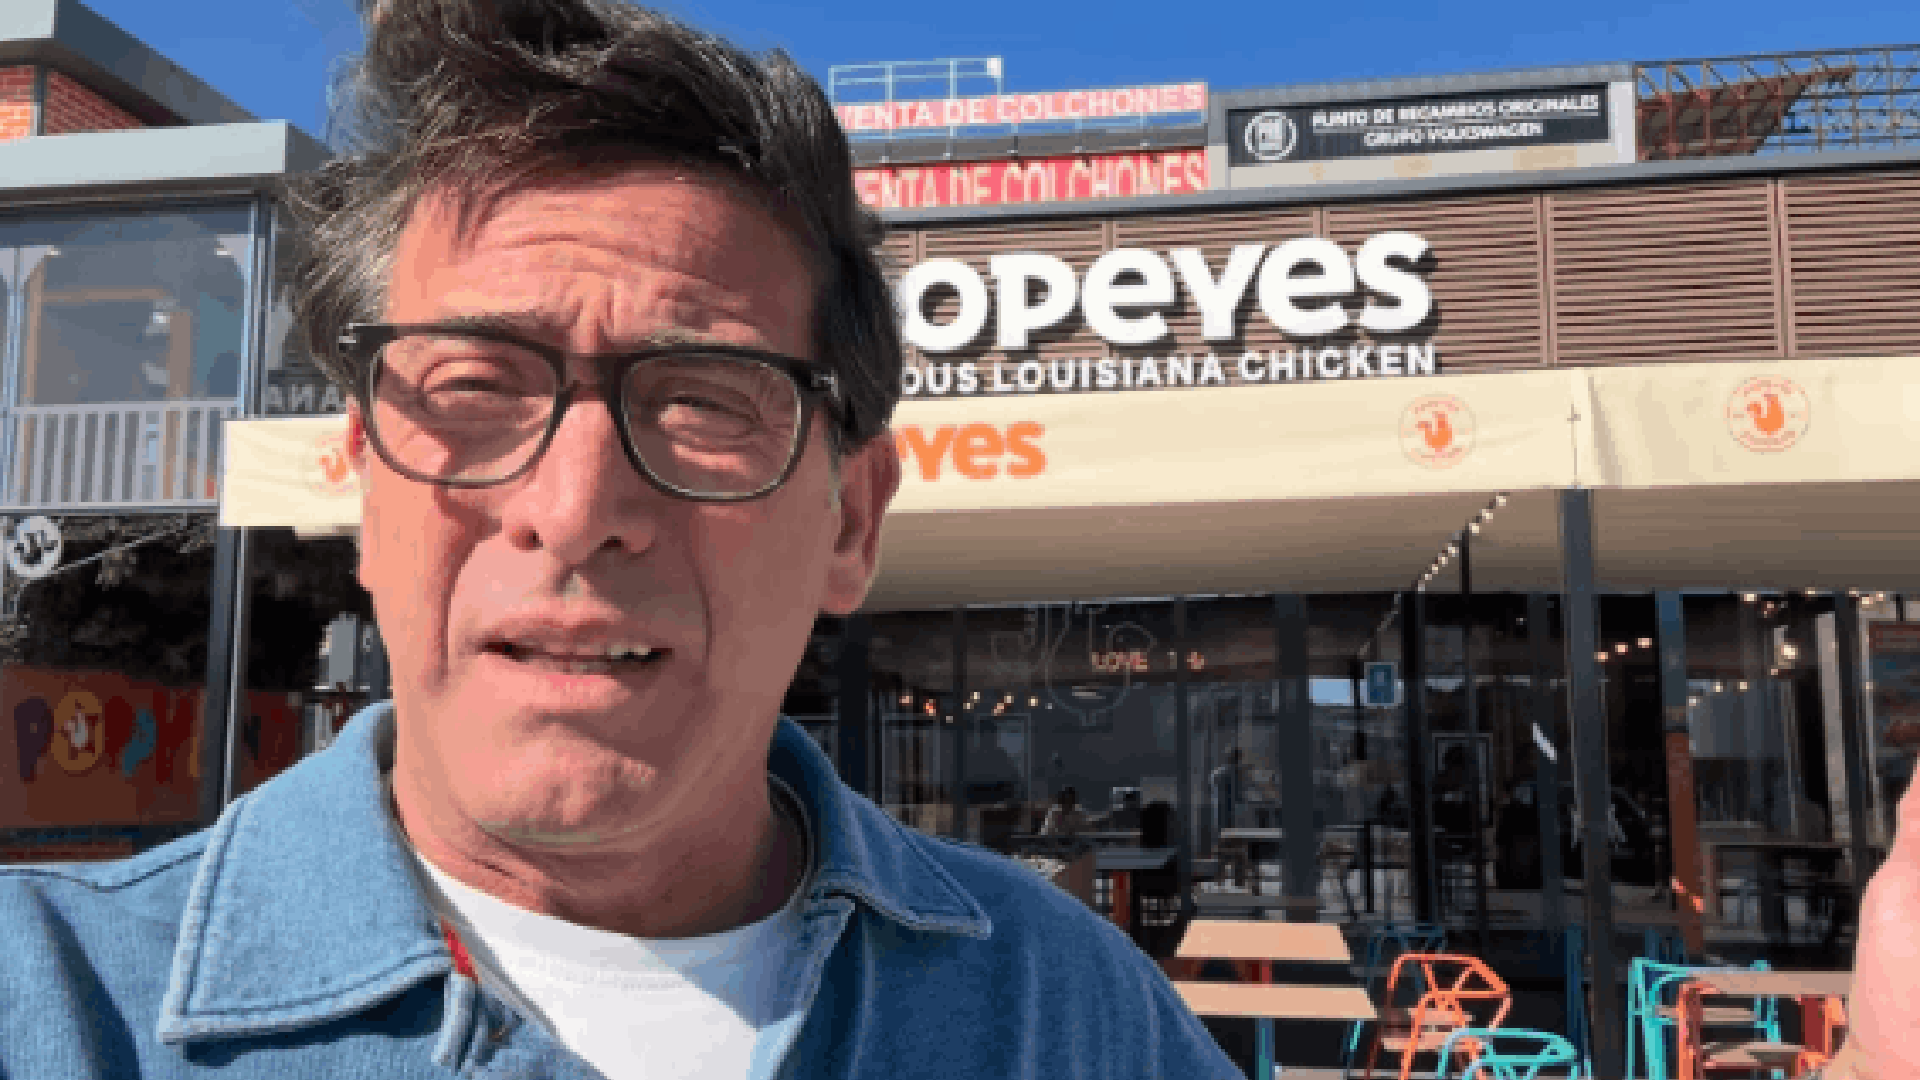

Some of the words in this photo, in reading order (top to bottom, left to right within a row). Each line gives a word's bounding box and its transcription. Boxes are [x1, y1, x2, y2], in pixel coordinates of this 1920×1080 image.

[840, 103, 938, 130] VENTA
[944, 98, 991, 124] DE
[996, 85, 1203, 122] COLCHONES
[1312, 109, 1368, 128] PUNTO
[1373, 107, 1394, 125] DE
[1400, 100, 1497, 122] RECAMBIOS
[1499, 94, 1599, 117] ORIGINALES
[1363, 128, 1422, 147] GRUPO
[1427, 122, 1543, 143] VOLKSWAGEN
[853, 166, 940, 208] ENTA
[947, 164, 992, 205] DE
[1000, 151, 1205, 202] COLCHONES
[902, 364, 978, 394] OUS
[993, 355, 1226, 392] LOUISIANA
[1238, 345, 1436, 380] CHICKEN
